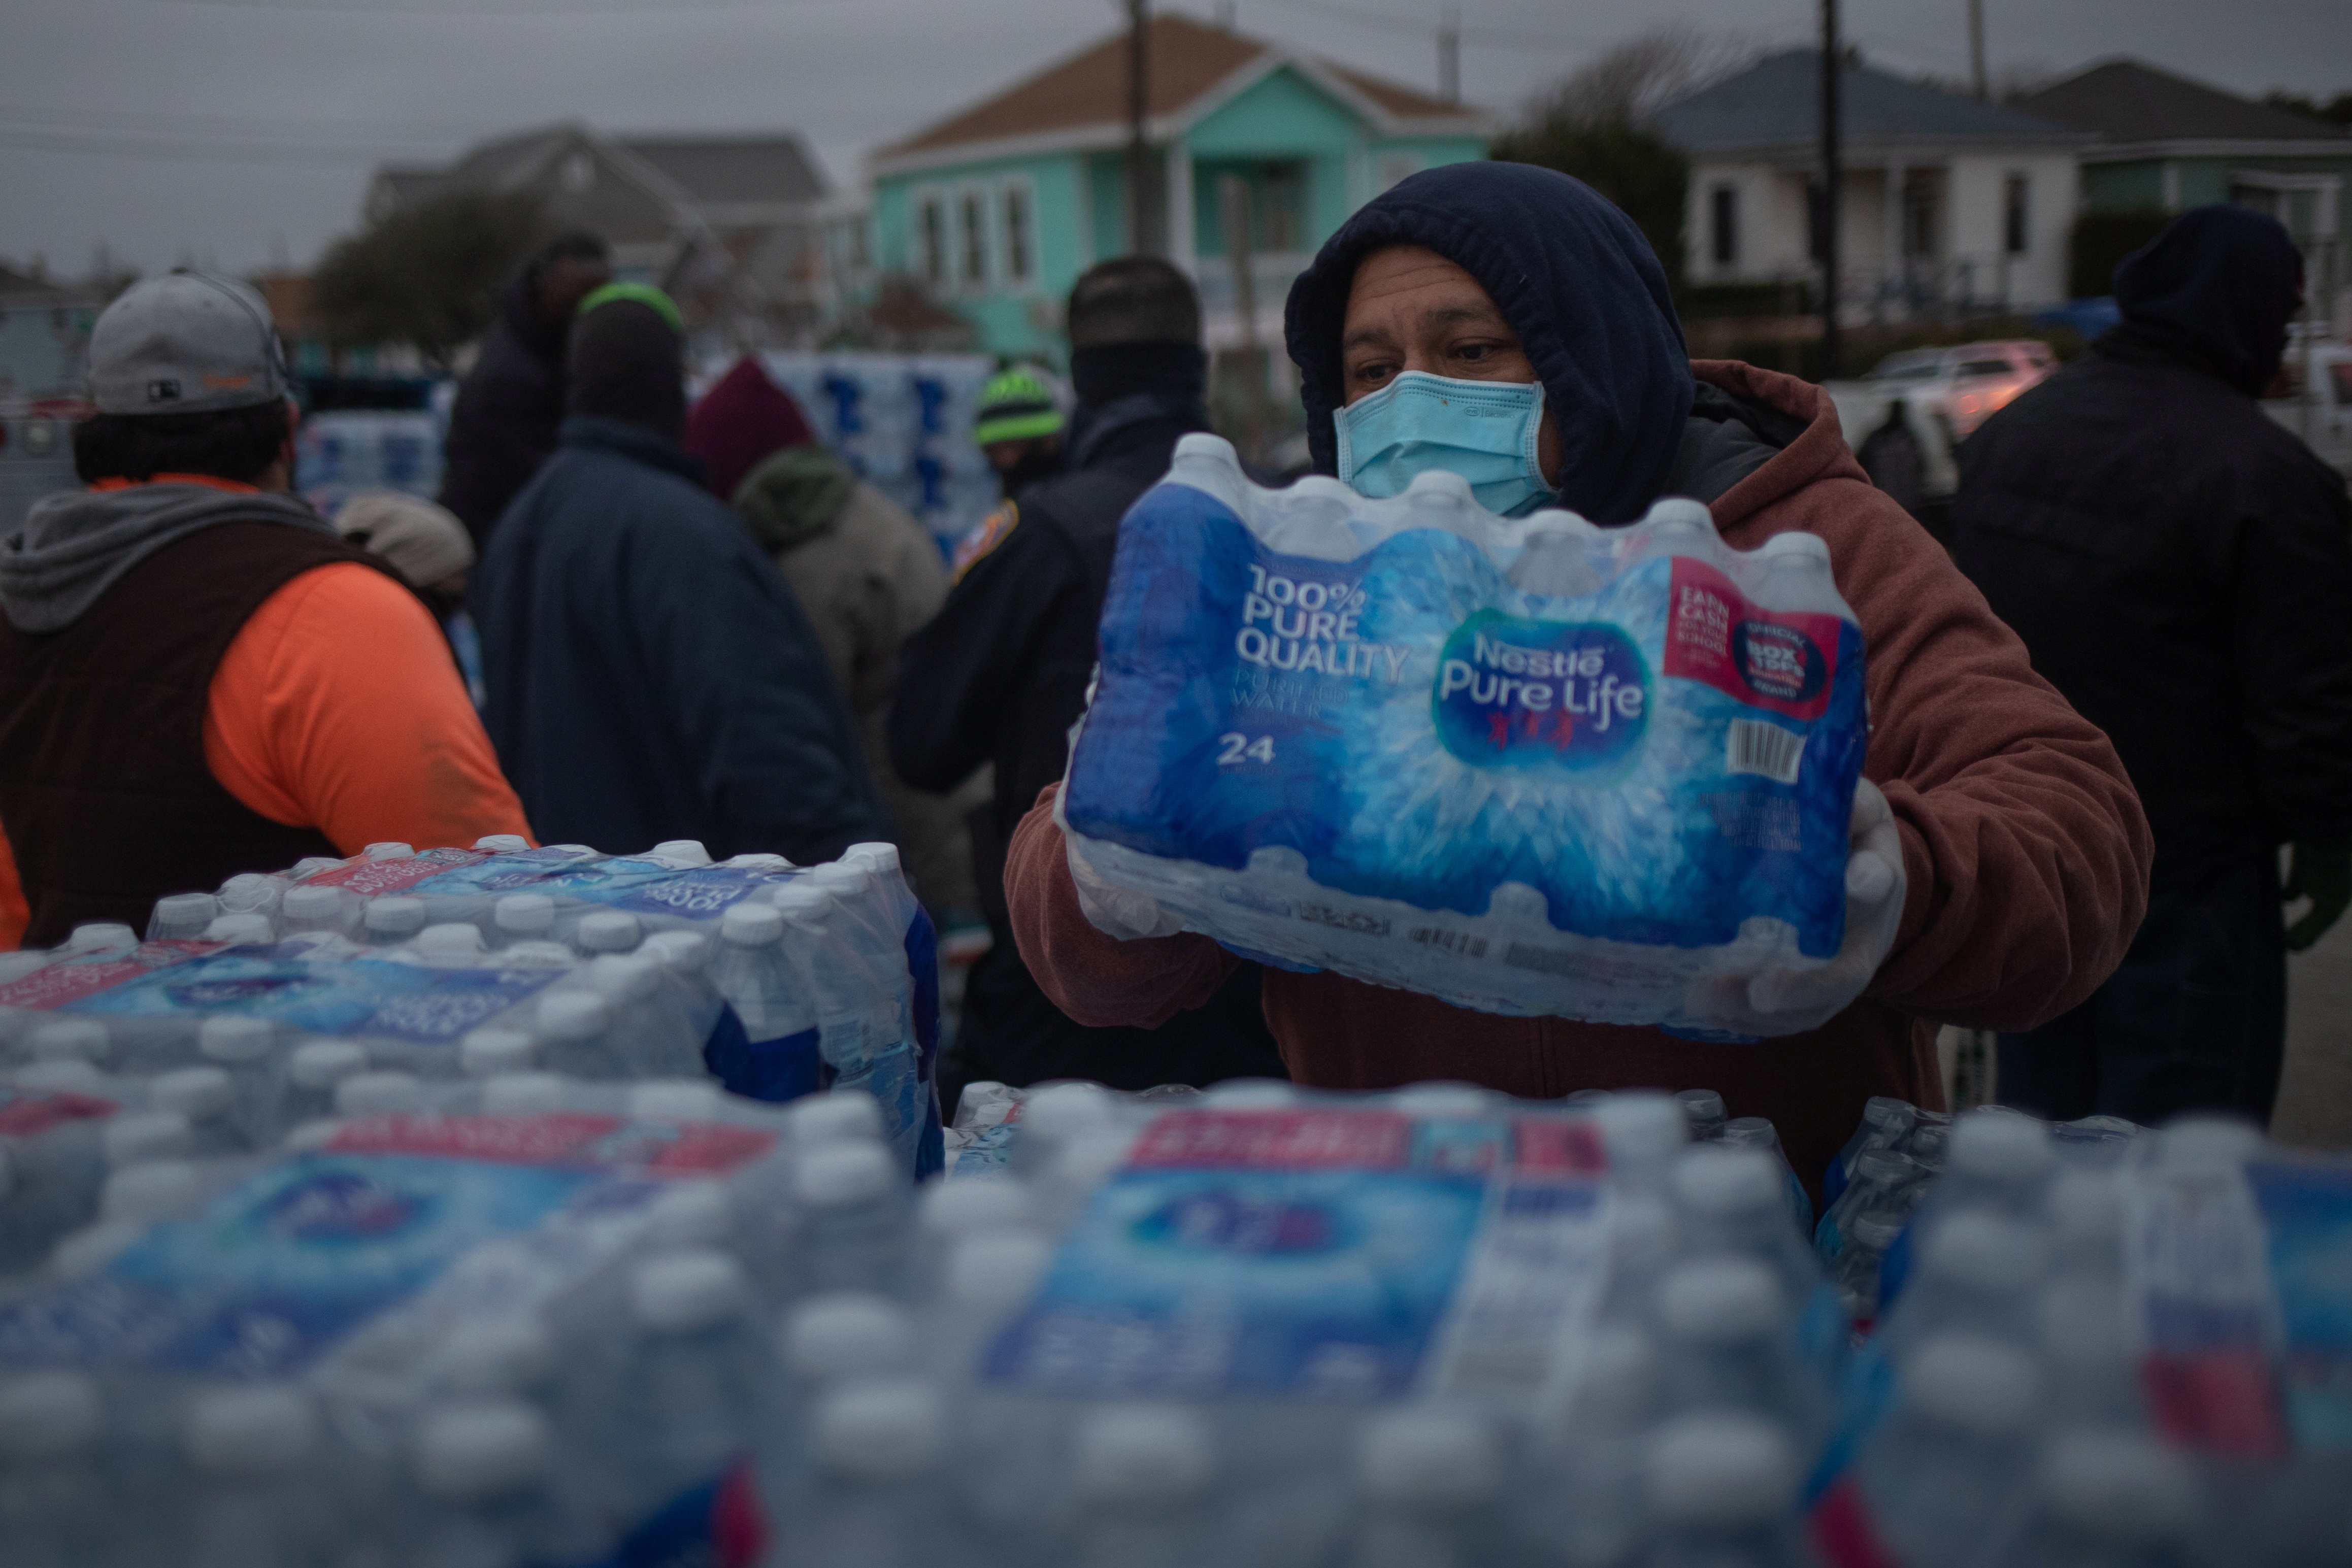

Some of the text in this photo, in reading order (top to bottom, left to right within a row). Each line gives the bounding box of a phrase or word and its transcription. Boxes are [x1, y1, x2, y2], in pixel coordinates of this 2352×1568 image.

[1247, 562, 1367, 611] 100%
[1243, 591, 1362, 642] PURE
[1235, 626, 1412, 683] QUALITY
[1440, 658, 1644, 732] Pure Life
[1216, 731, 1276, 765] 24
